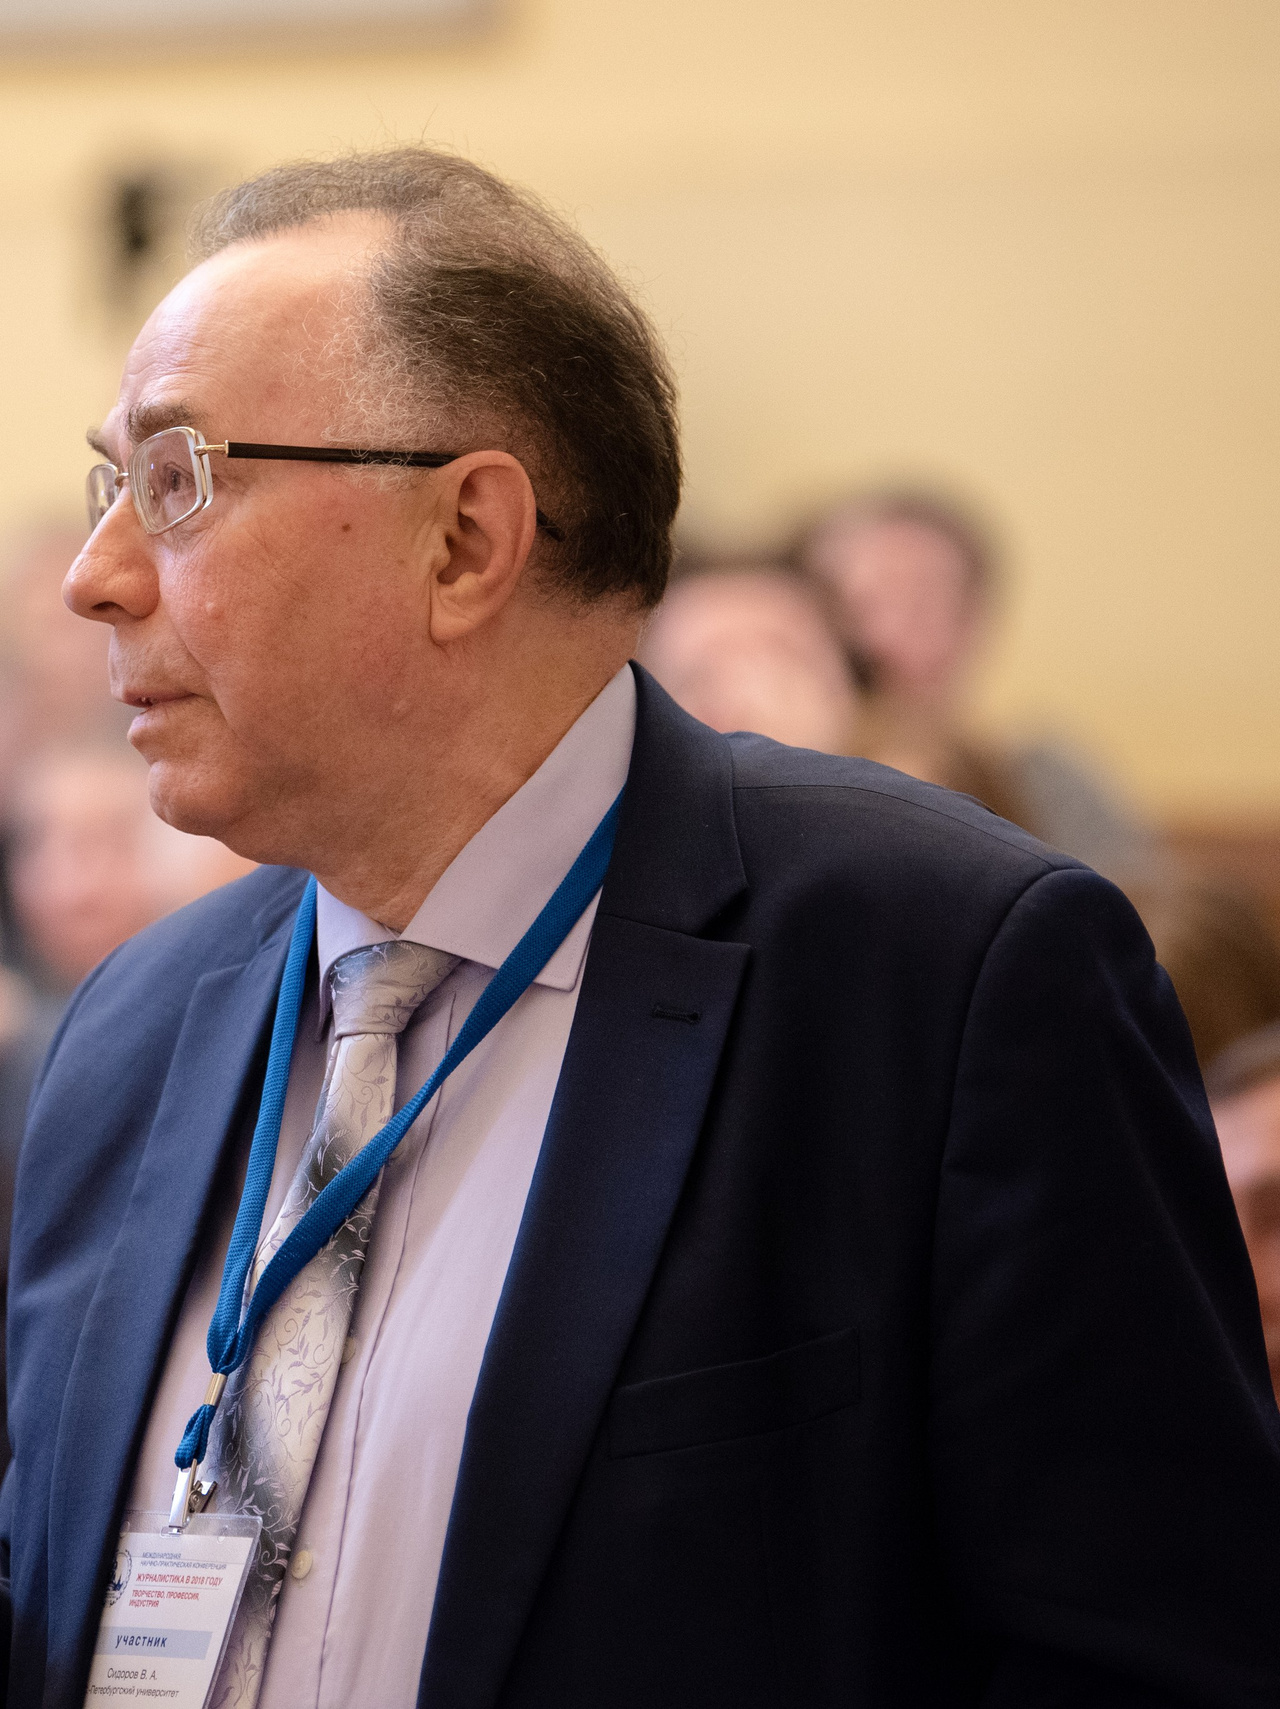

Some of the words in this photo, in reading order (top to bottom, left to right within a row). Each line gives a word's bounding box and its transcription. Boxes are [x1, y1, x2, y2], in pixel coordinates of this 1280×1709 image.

[136, 1573, 185, 1584] ЖУРНАЛИСТИКА
[185, 1576, 191, 1584] В
[191, 1576, 204, 1584] 2018
[205, 1577, 223, 1586] ГОДУ
[132, 1590, 165, 1599] ТВОРЧЕСТВО,
[166, 1591, 200, 1600] ПРОФЕССИЯ,
[129, 1599, 159, 1608] ИНДУСТРИЯ
[115, 1634, 168, 1648] участник
[107, 1667, 139, 1681] Сидоров
[140, 1669, 147, 1680] В.
[149, 1670, 157, 1680] А.
[88, 1685, 135, 1697] -Петербургский
[135, 1689, 180, 1698] университет
